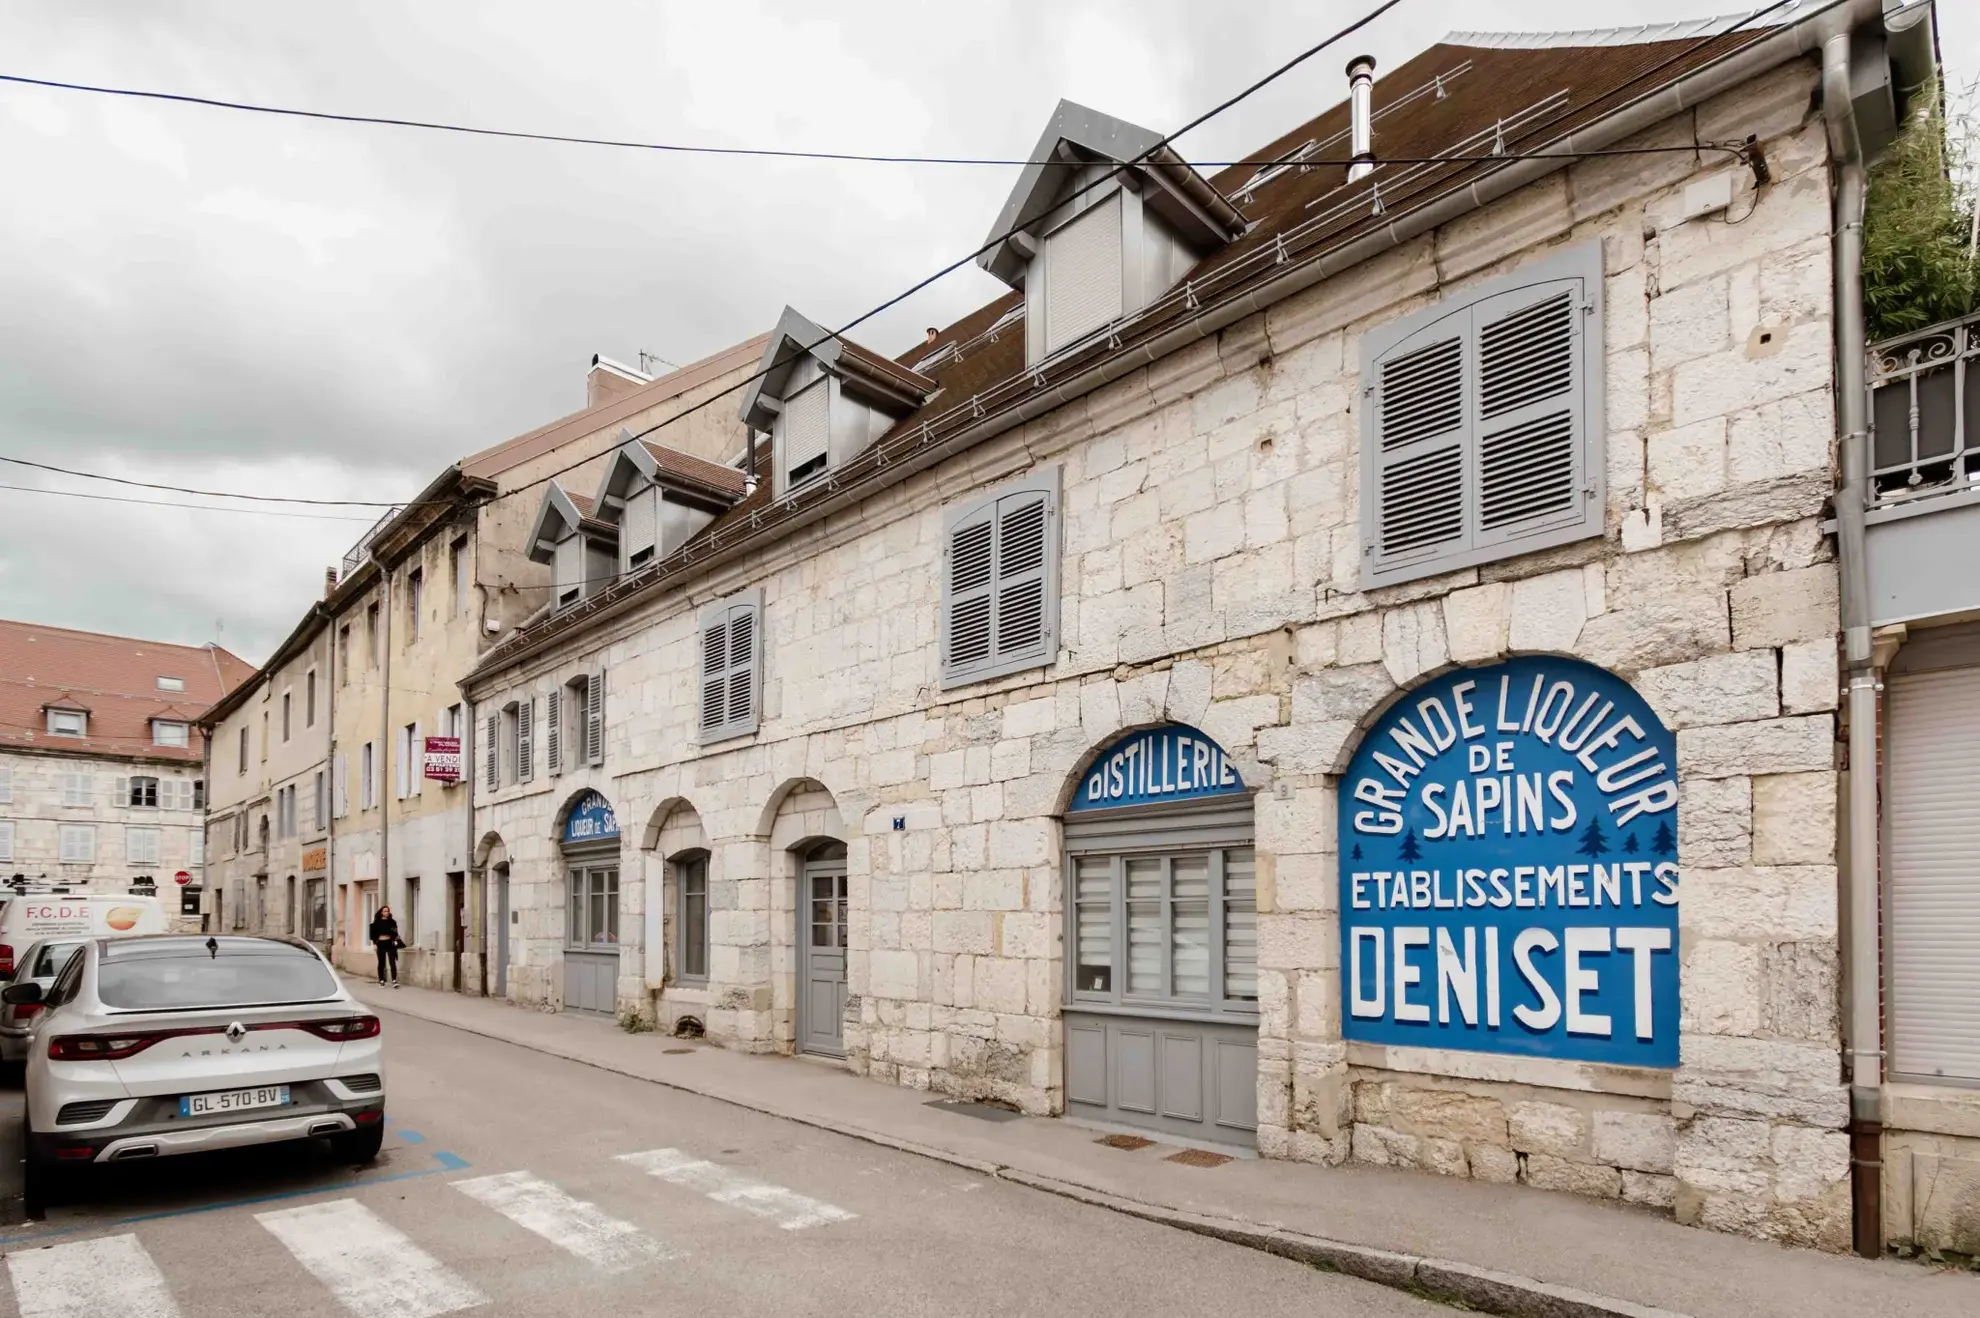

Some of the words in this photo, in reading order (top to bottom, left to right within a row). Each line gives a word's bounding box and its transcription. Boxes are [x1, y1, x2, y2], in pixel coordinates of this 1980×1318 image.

[435, 755, 460, 763] VEND
[1088, 735, 1236, 801] DISTILLERIE
[1354, 680, 1486, 835] GRANDE
[1497, 673, 1678, 827] LIQUEUR
[1469, 741, 1515, 773] DE
[1421, 770, 1577, 839] SAPINS
[571, 818, 594, 838] LIQUEUR
[603, 813, 620, 833] SAP
[1351, 861, 1679, 909] ETABLISSEMENTS
[1350, 926, 1672, 1040] DENISET
[181, 1044, 287, 1058] ARKANA
[193, 1088, 277, 1112] GL-570-BV
